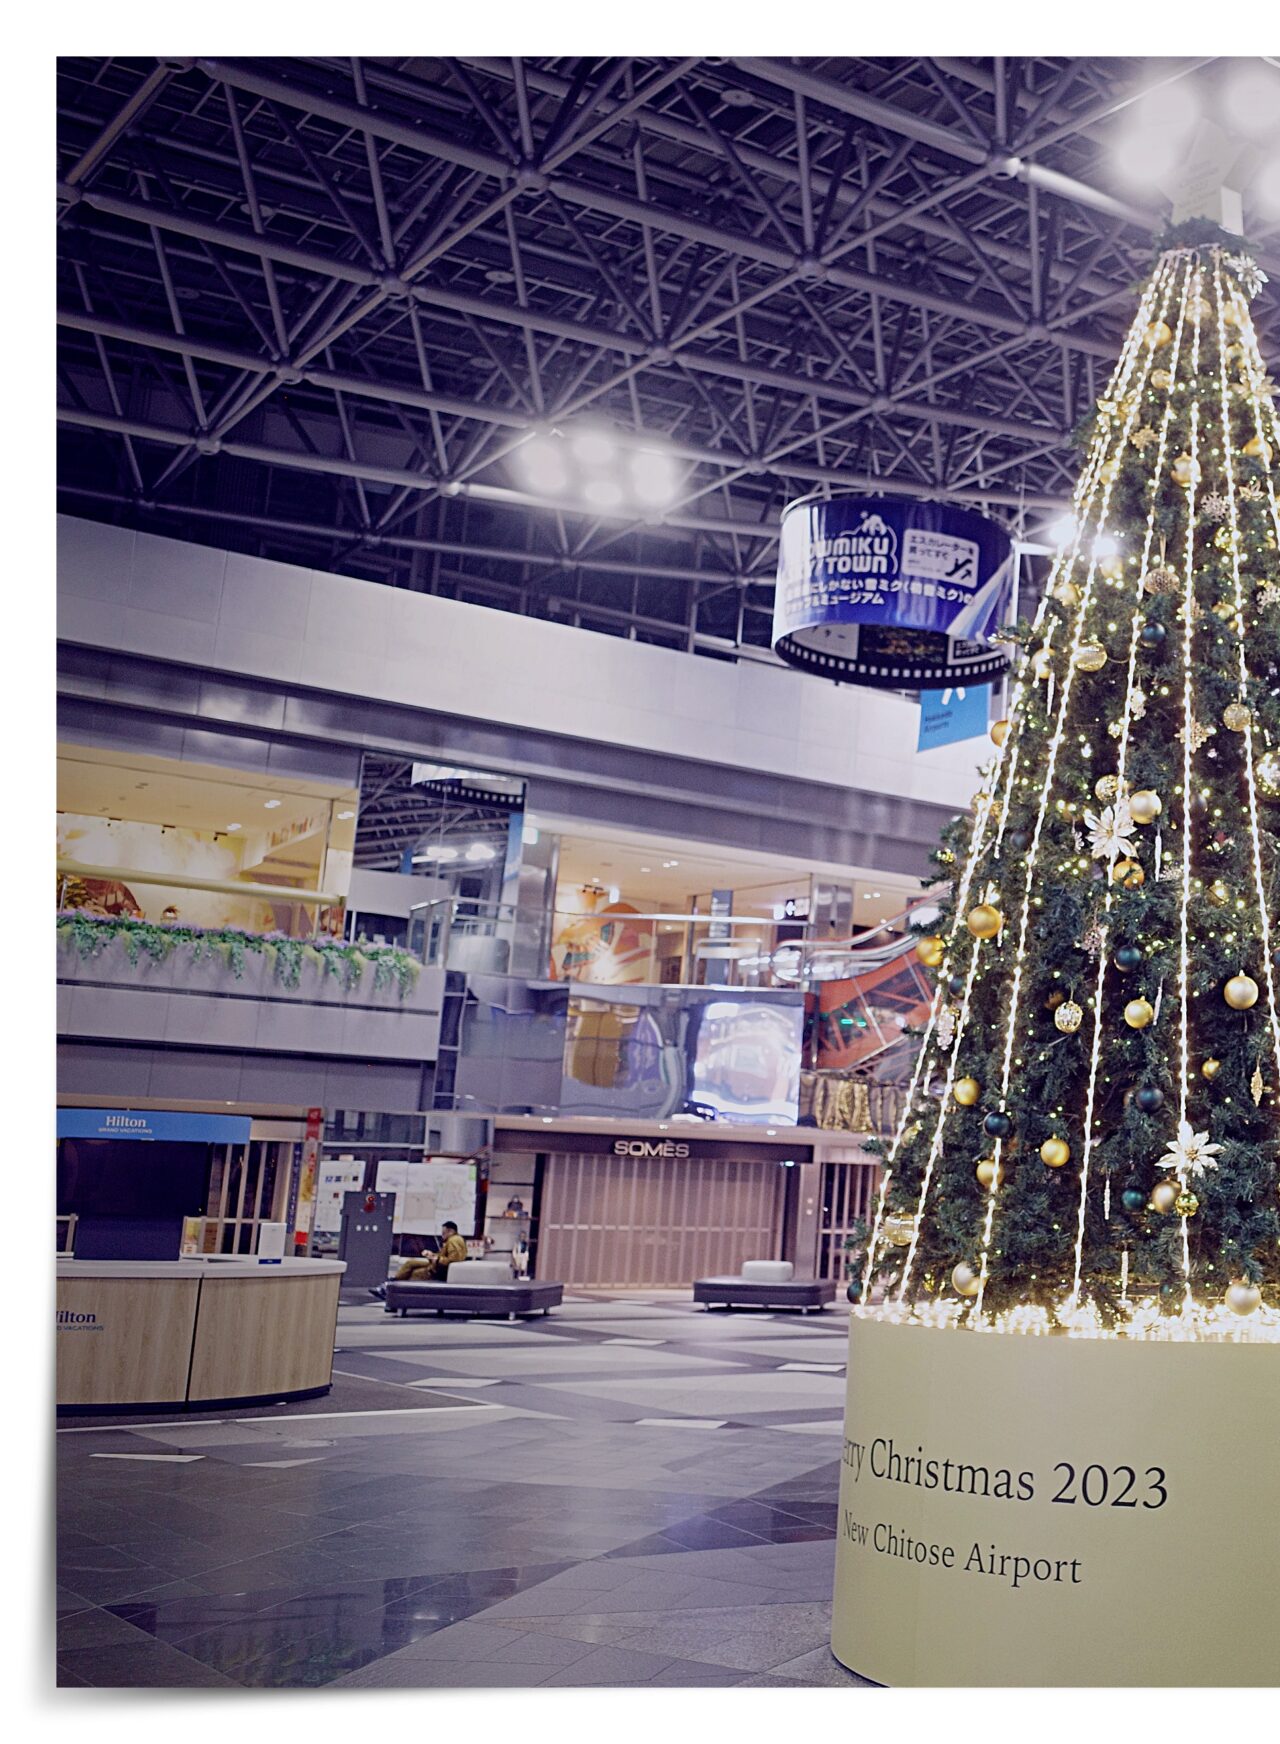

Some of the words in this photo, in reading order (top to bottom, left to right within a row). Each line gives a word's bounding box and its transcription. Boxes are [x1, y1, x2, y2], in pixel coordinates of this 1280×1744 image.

[824, 554, 888, 575] TOWN
[105, 1115, 147, 1128] Hilton
[614, 1139, 690, 1159] SOMÈS
[844, 1438, 866, 1482] rry
[870, 1438, 1035, 1501] Christmas
[1051, 1461, 1169, 1509] 2023
[843, 1508, 869, 1547] New
[873, 1523, 955, 1568] Chitose
[963, 1542, 1083, 1588] Airport
